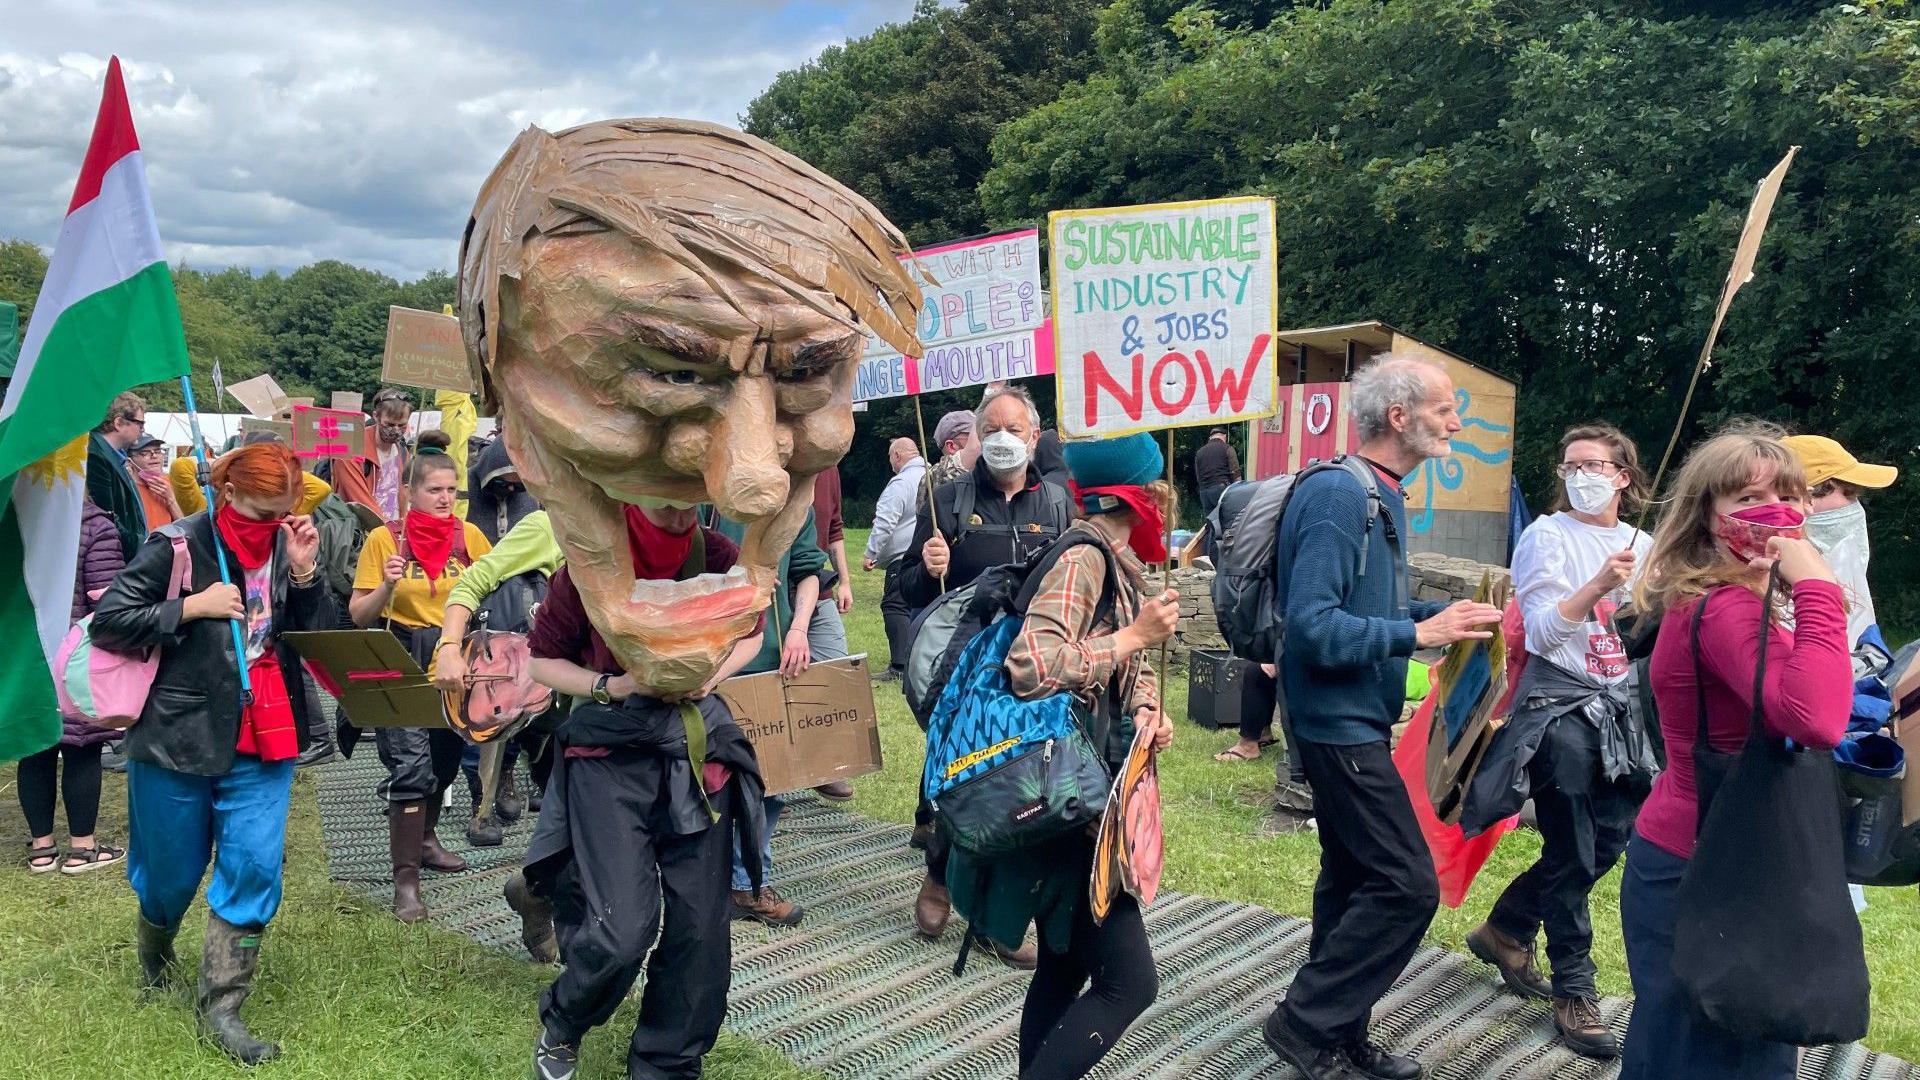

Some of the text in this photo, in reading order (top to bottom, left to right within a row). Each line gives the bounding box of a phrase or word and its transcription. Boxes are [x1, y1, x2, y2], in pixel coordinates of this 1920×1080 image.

[1064, 213, 1261, 270] SUSTAINABLE
[1074, 264, 1253, 314] INDUSTRY
[1120, 309, 1229, 356] & JOBS
[924, 338, 1033, 390] MOUTH
[1083, 334, 1272, 428] NOW
[1016, 804, 1043, 820] EASTPAK
